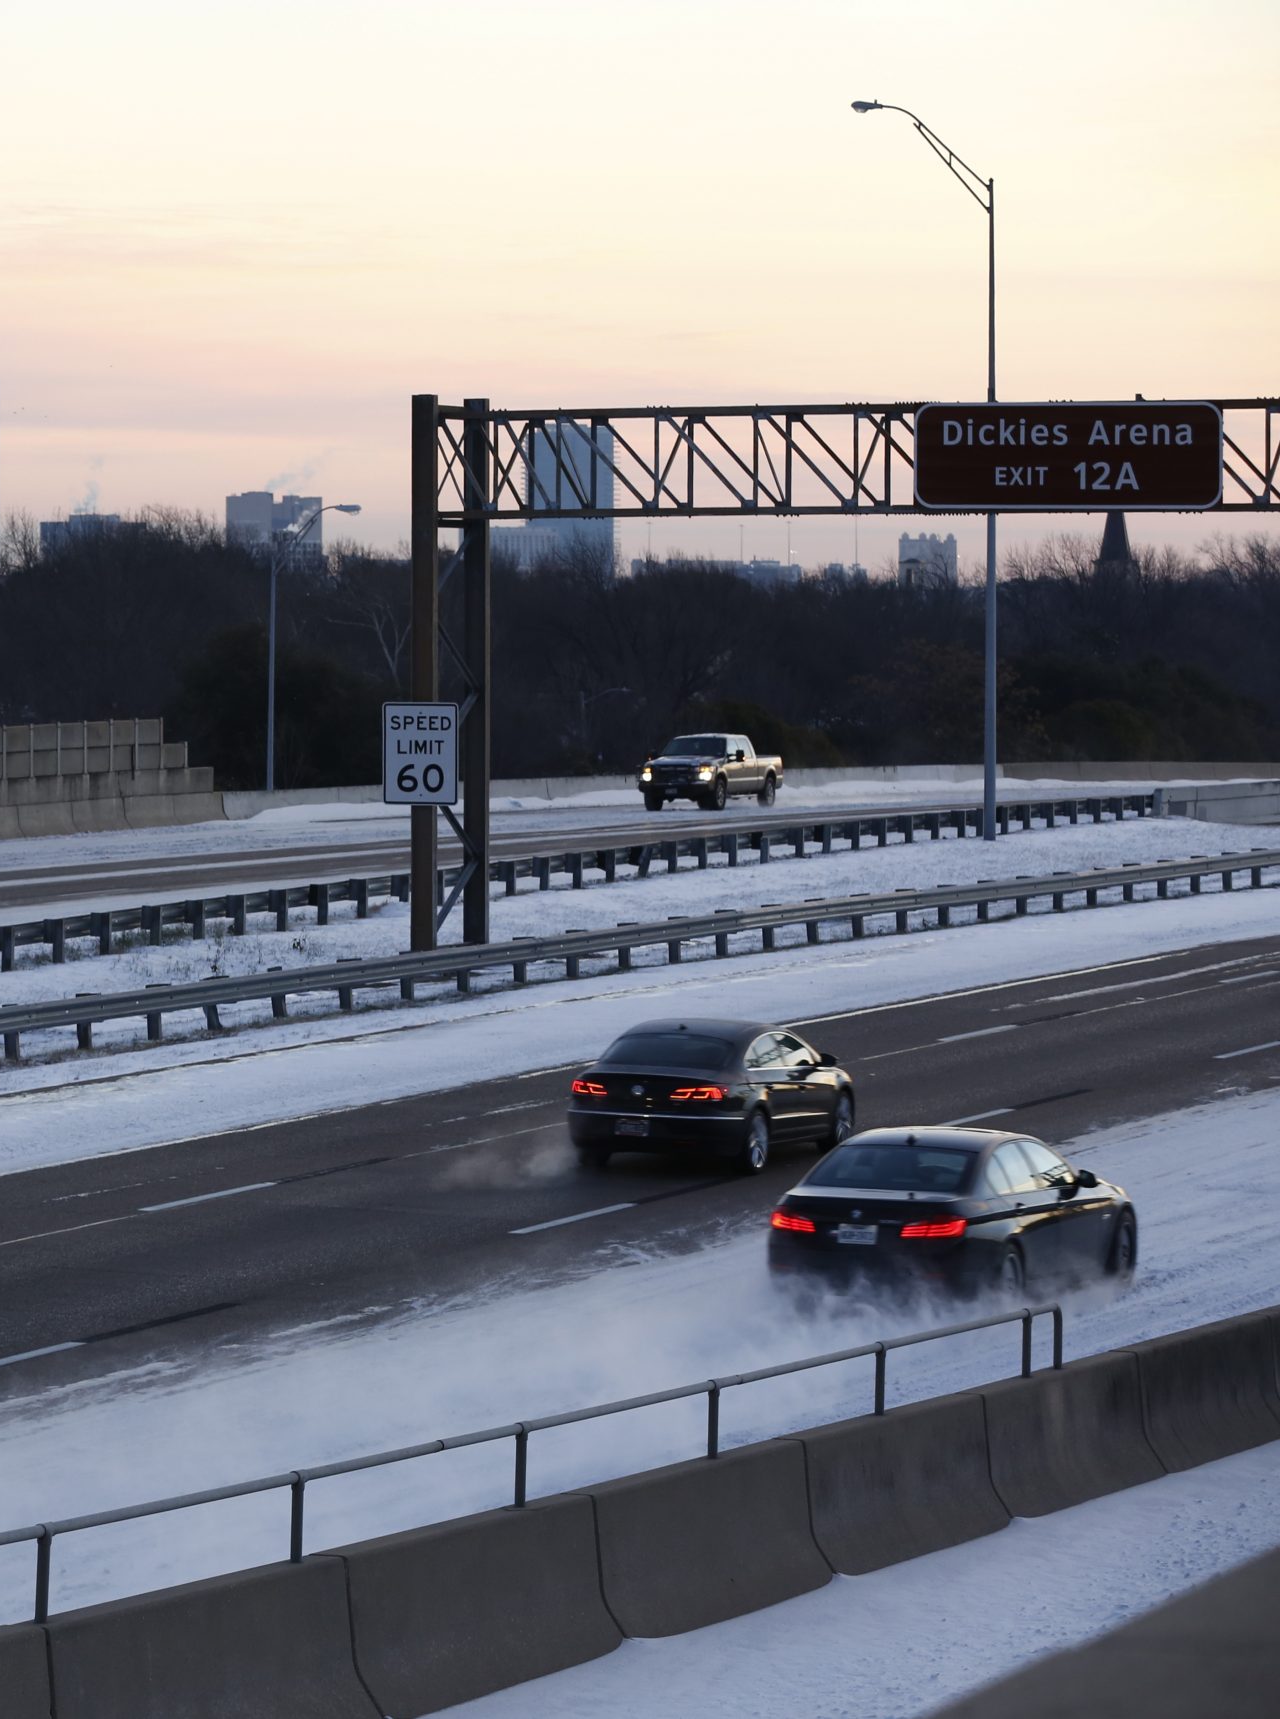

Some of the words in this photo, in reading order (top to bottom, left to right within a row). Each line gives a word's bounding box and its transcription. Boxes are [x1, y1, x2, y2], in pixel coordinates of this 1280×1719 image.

[942, 418, 1069, 446] Dickies
[1087, 419, 1194, 446] Arena
[994, 466, 1049, 486] EXIT
[1072, 461, 1140, 491] 12A
[390, 715, 452, 731] SPEED
[396, 740, 445, 755] LIMIT
[396, 763, 445, 793] 60
